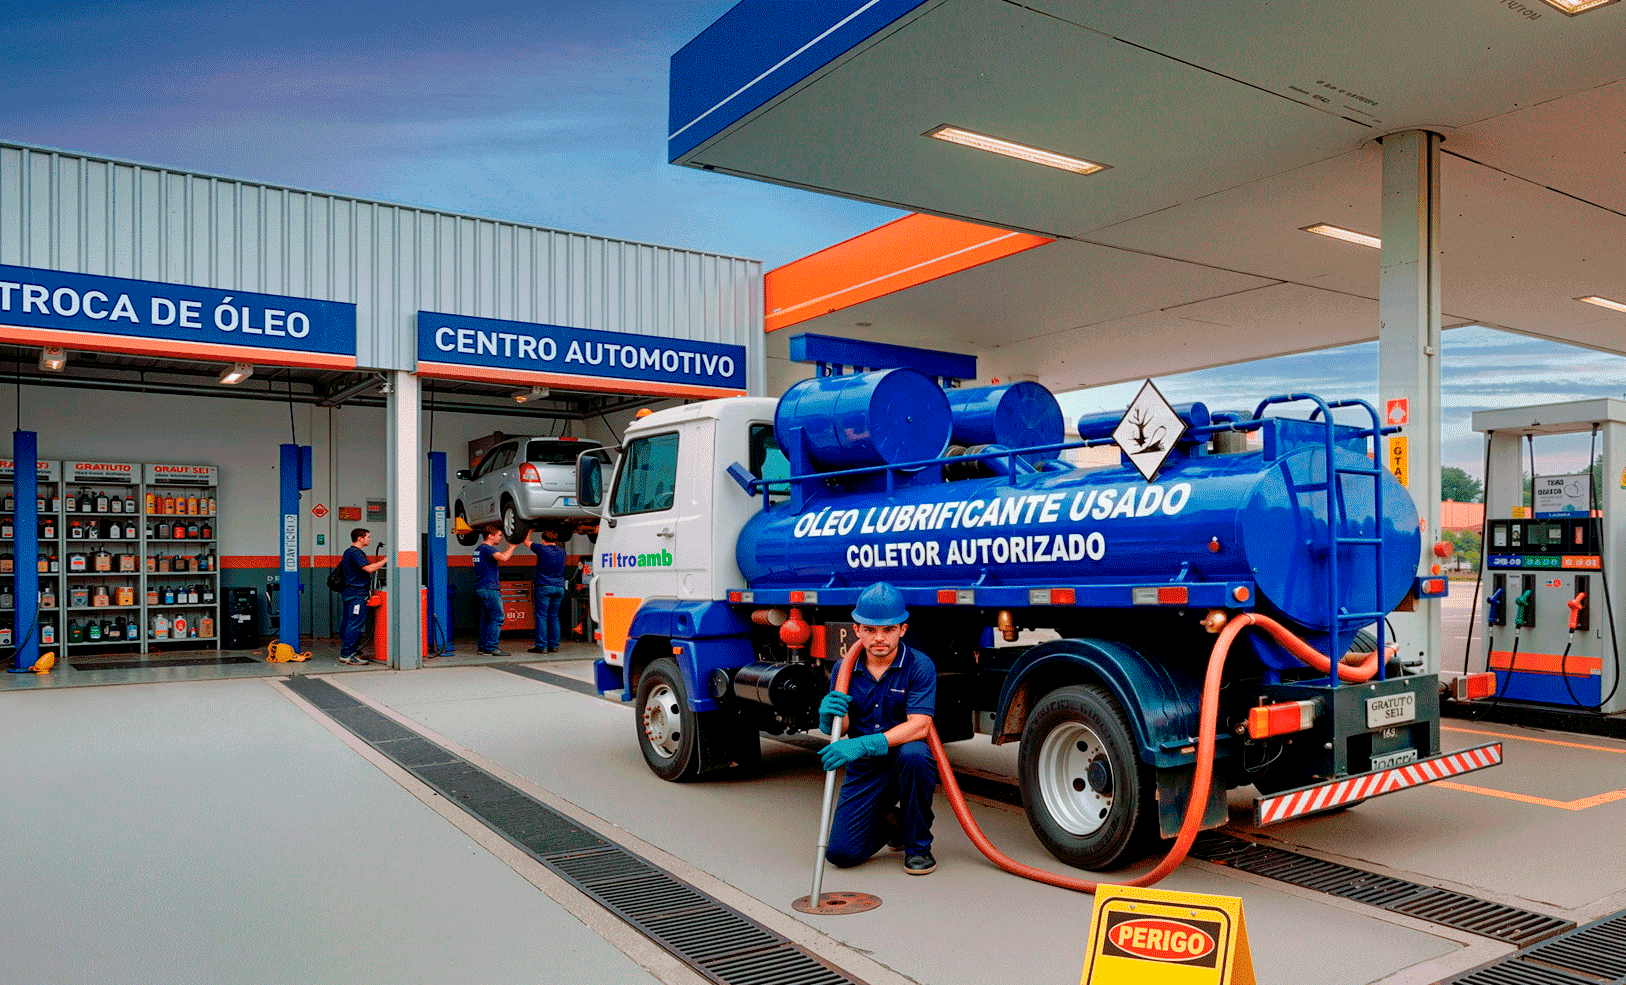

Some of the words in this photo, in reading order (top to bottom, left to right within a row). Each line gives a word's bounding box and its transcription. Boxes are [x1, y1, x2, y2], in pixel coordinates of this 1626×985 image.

[0, 281, 140, 324] TROCA
[151, 297, 202, 329] DE
[214, 296, 310, 338] ÓLEO
[435, 327, 557, 361] CENTRO
[565, 341, 735, 378] AUTOMOTIVO
[860, 493, 1065, 535] LUBRIFICANTE
[1068, 482, 1192, 521] USADO
[601, 548, 673, 568] Filtroamb
[846, 541, 942, 569] COLETOR
[946, 531, 1106, 565] AUTORIZADO
[1117, 925, 1205, 955] PERIGO
